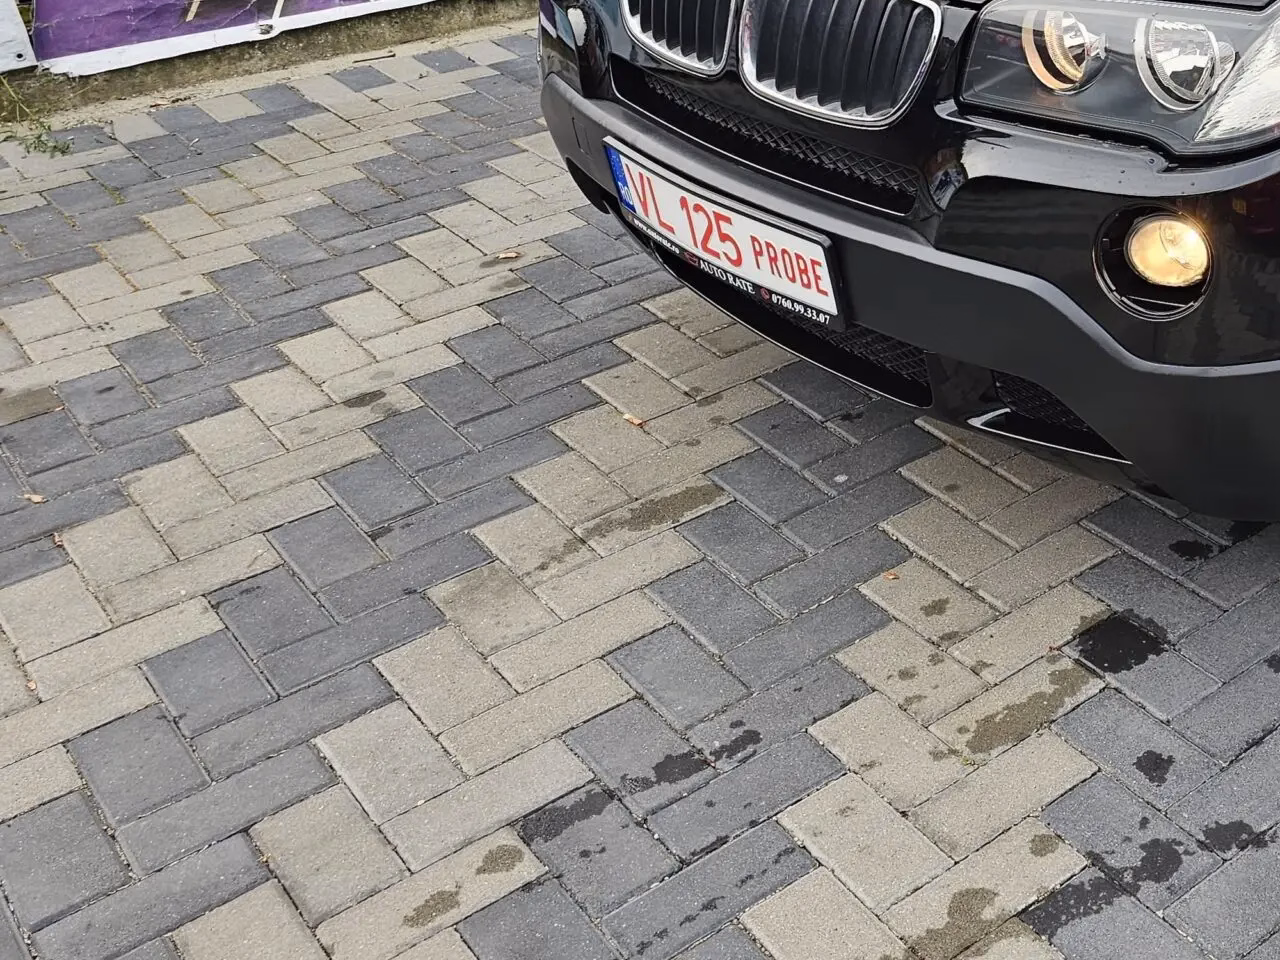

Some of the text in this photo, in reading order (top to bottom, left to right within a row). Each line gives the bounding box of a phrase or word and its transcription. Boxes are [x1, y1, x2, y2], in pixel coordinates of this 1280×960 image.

[624, 162, 829, 297] VL 125 PROBE
[700, 259, 756, 295] AUTO RATE
[771, 293, 831, 325] 0760.99.33.07
